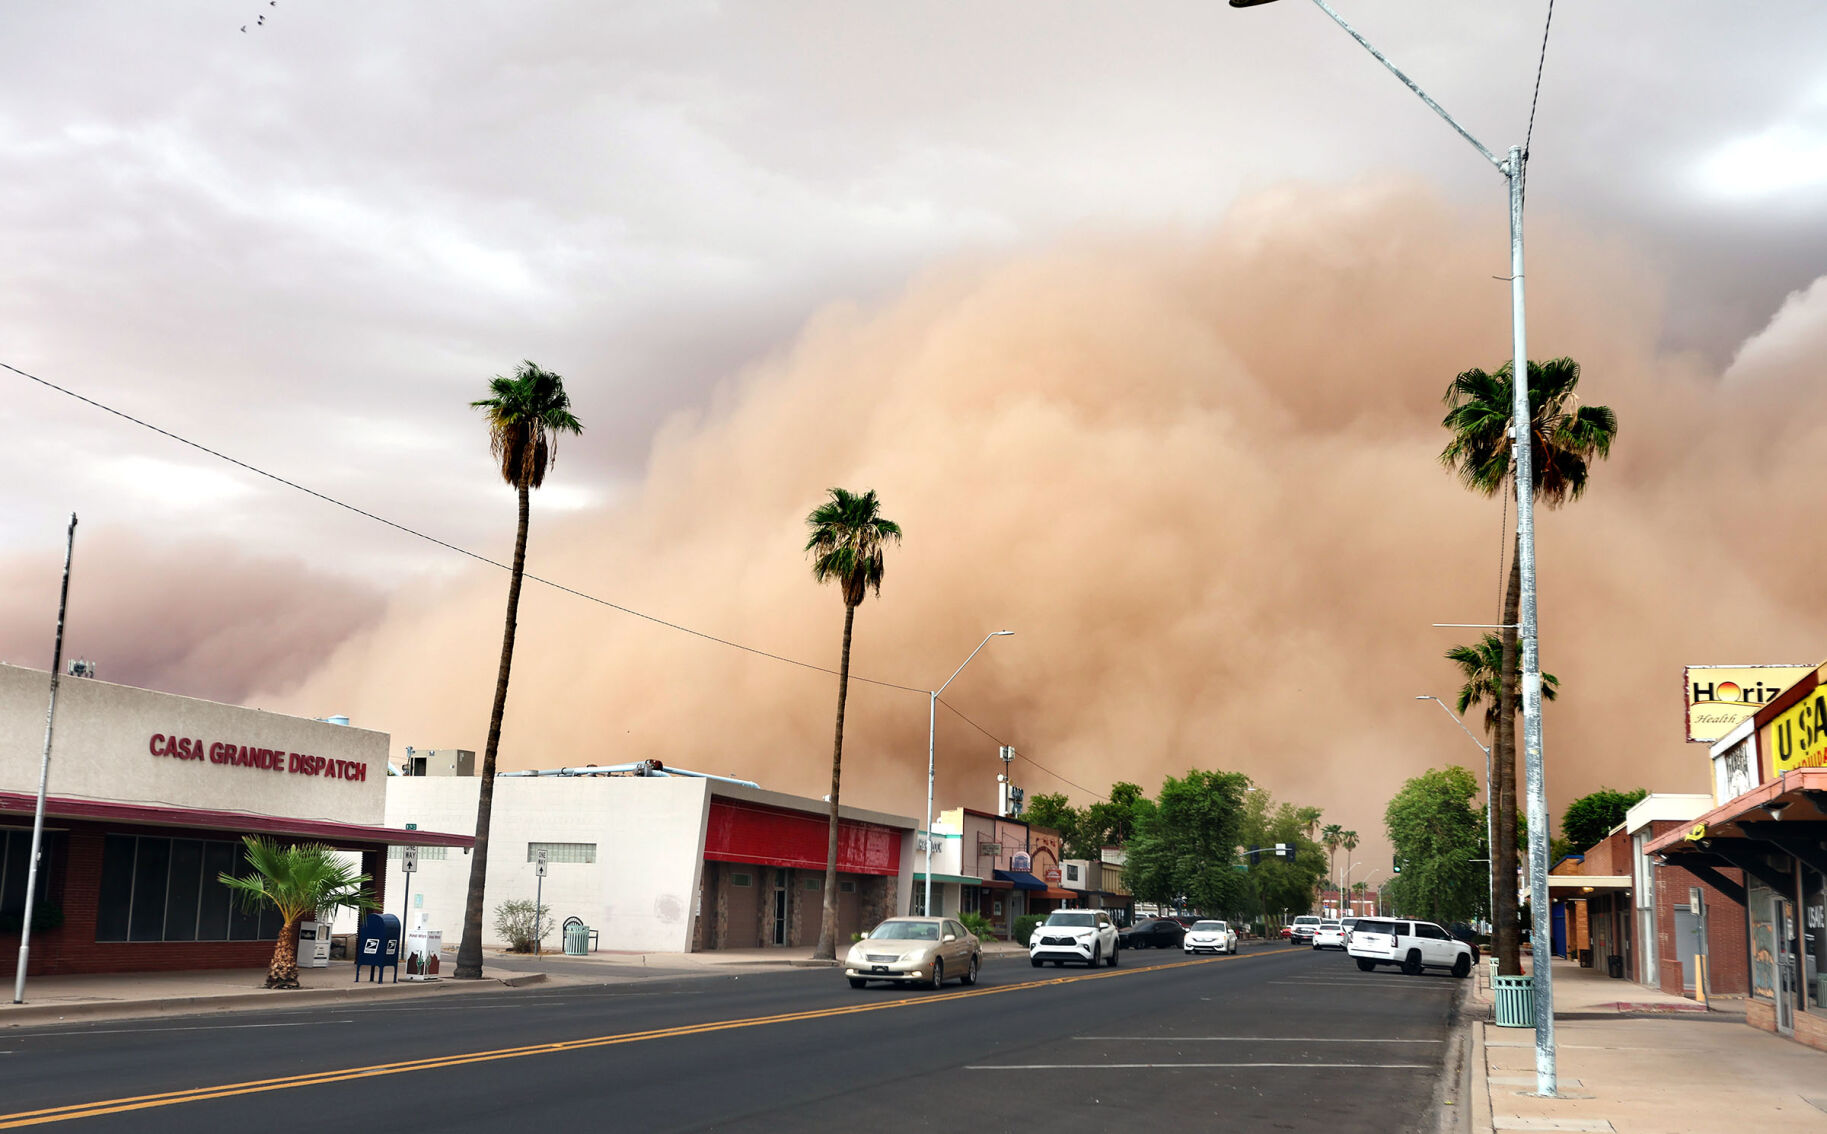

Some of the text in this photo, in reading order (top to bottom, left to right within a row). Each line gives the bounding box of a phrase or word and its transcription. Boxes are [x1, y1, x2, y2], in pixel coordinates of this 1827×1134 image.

[1694, 713, 1738, 724] Health
[150, 733, 367, 782] CASA GRANDE DISPATCH
[405, 851, 416, 859] WAY
